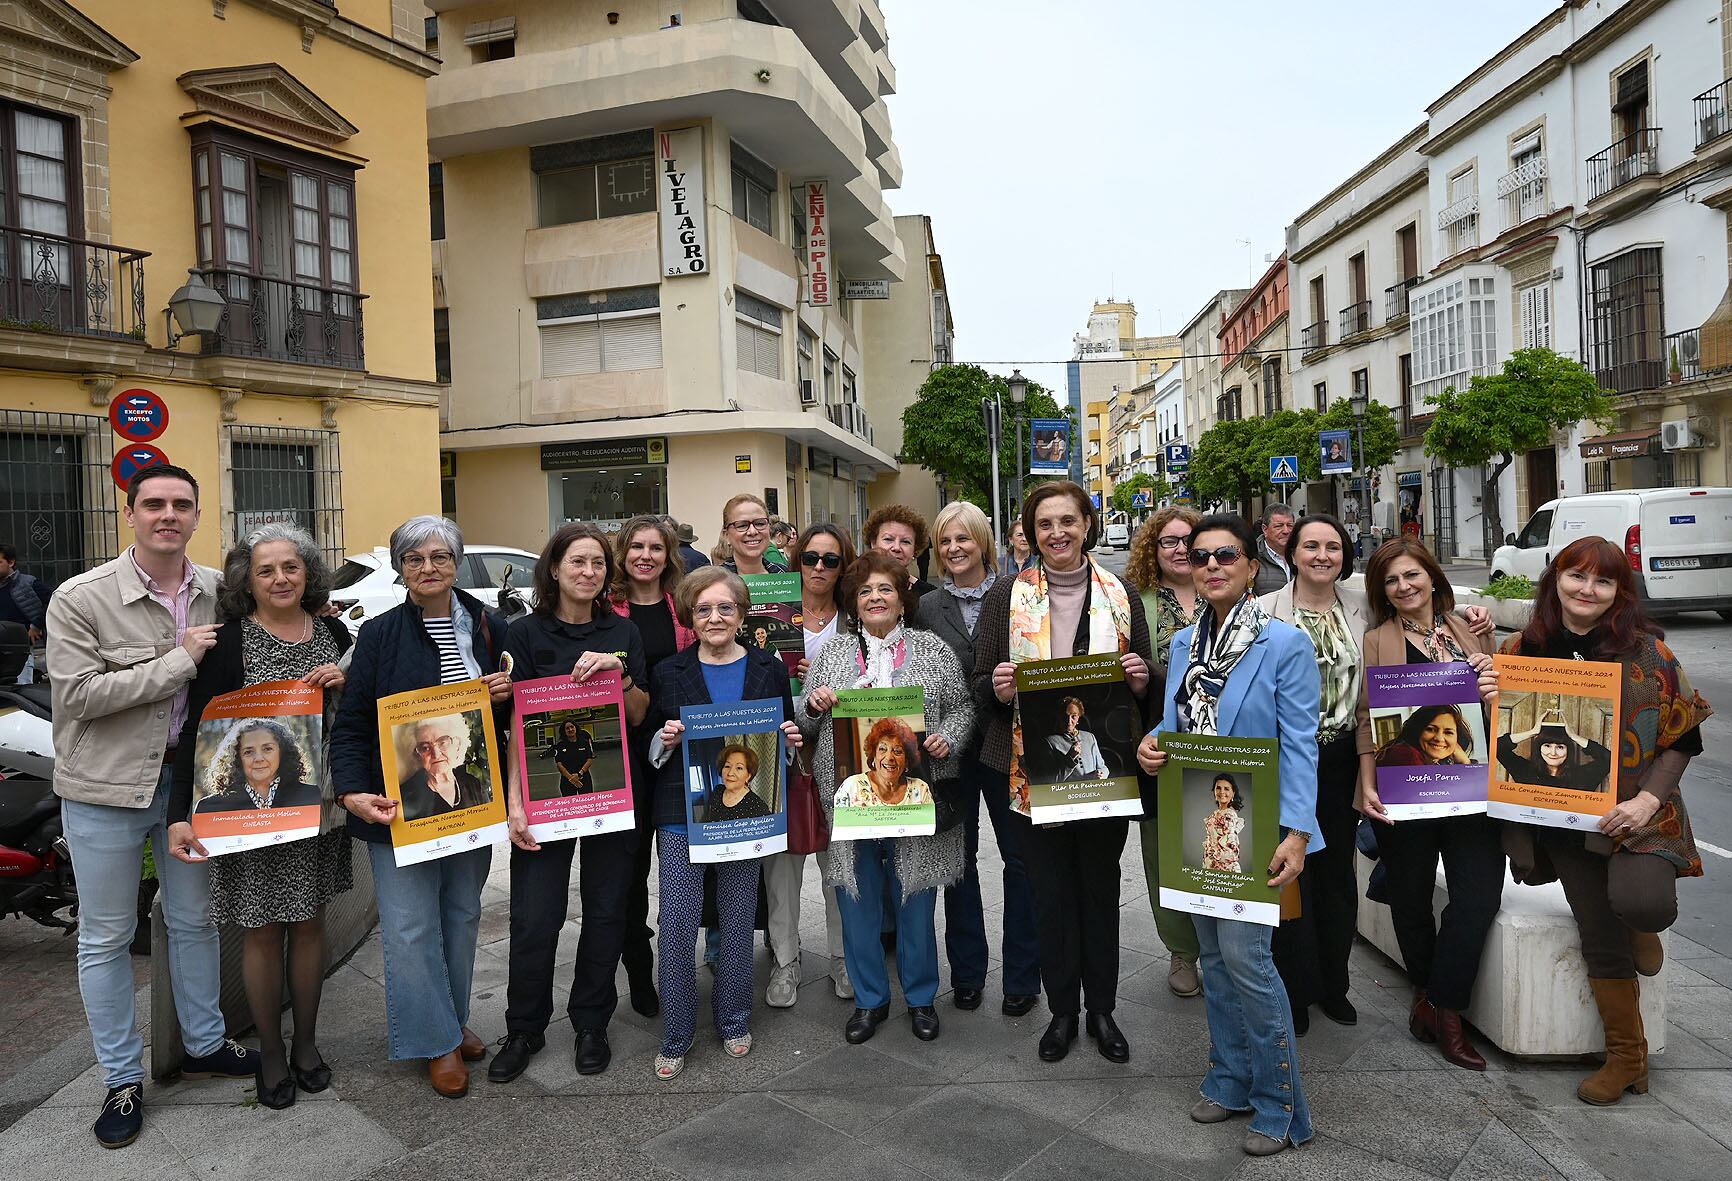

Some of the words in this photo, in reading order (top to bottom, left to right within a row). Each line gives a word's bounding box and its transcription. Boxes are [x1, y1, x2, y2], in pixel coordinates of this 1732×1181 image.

[660, 133, 705, 272] NIVELAGRO
[809, 183, 825, 236] VENTA
[811, 251, 828, 303] PISOS
[1171, 446, 1183, 459] P
[1178, 486, 1186, 497] P
[244, 517, 253, 525] SE
[255, 514, 290, 525] ALQUILA
[1660, 559, 1681, 567] 5869
[1023, 667, 1048, 676] TRIBUTO
[1068, 662, 1099, 671] NUESTRAS
[1419, 669, 1452, 677] NUESTRAS
[1501, 664, 1531, 672] TRIBUTO
[1539, 666, 1553, 674] LAS
[1554, 668, 1593, 677] NUESTRAS
[521, 686, 548, 695] TRIBUTO
[567, 680, 599, 689] NUESTRAS
[384, 701, 410, 711] TRIBUTO
[431, 690, 465, 702] NUESTRAS
[465, 687, 482, 695] 2024
[687, 712, 713, 720] TRIBUTO
[732, 708, 761, 716] NUESTRAS
[1165, 741, 1192, 750] TRIBUTO
[1214, 746, 1251, 754] NUESTRAS
[1170, 753, 1192, 762] Mujeres
[1192, 756, 1221, 765] Jerezanas
[1240, 759, 1266, 767] Historia
[1406, 773, 1432, 784] Josefa
[1435, 773, 1461, 781] Parra
[1499, 784, 1516, 792] Elisa
[1533, 796, 1568, 806] ESCRITORA
[212, 814, 255, 822] Inmaculada
[1204, 870, 1231, 879] Santiago
[1201, 884, 1234, 894] CANTANTE
